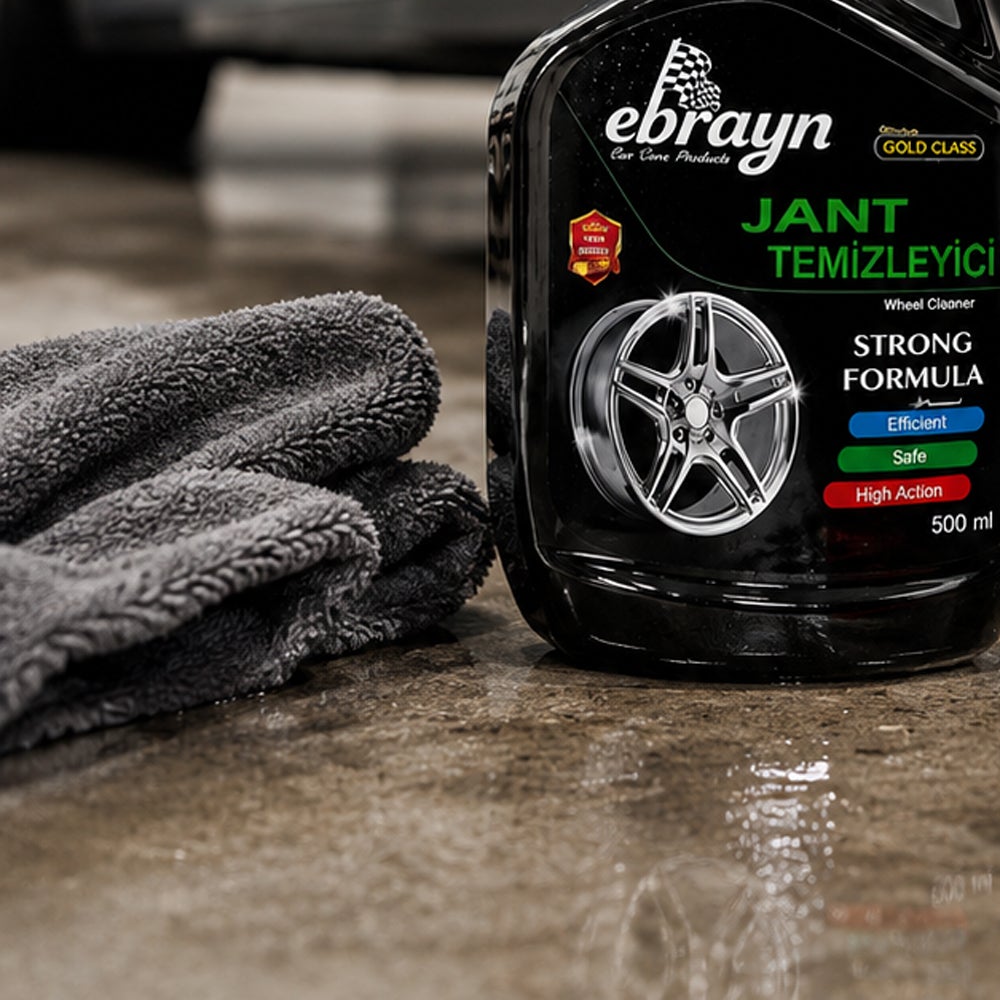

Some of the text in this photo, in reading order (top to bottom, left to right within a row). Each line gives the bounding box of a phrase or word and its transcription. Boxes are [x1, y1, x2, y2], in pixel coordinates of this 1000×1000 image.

[605, 48, 832, 176] ebrayn
[610, 146, 634, 160] Car
[883, 140, 977, 155] GOLD CLASS
[741, 198, 908, 233] JANT
[883, 298, 924, 311] Wheel
[853, 331, 972, 358] STRONG
[843, 363, 984, 391] FORMULA
[887, 415, 948, 432] Efficient
[892, 448, 928, 465] Safe
[856, 484, 944, 505] High Action
[931, 510, 993, 534] 500 ml
